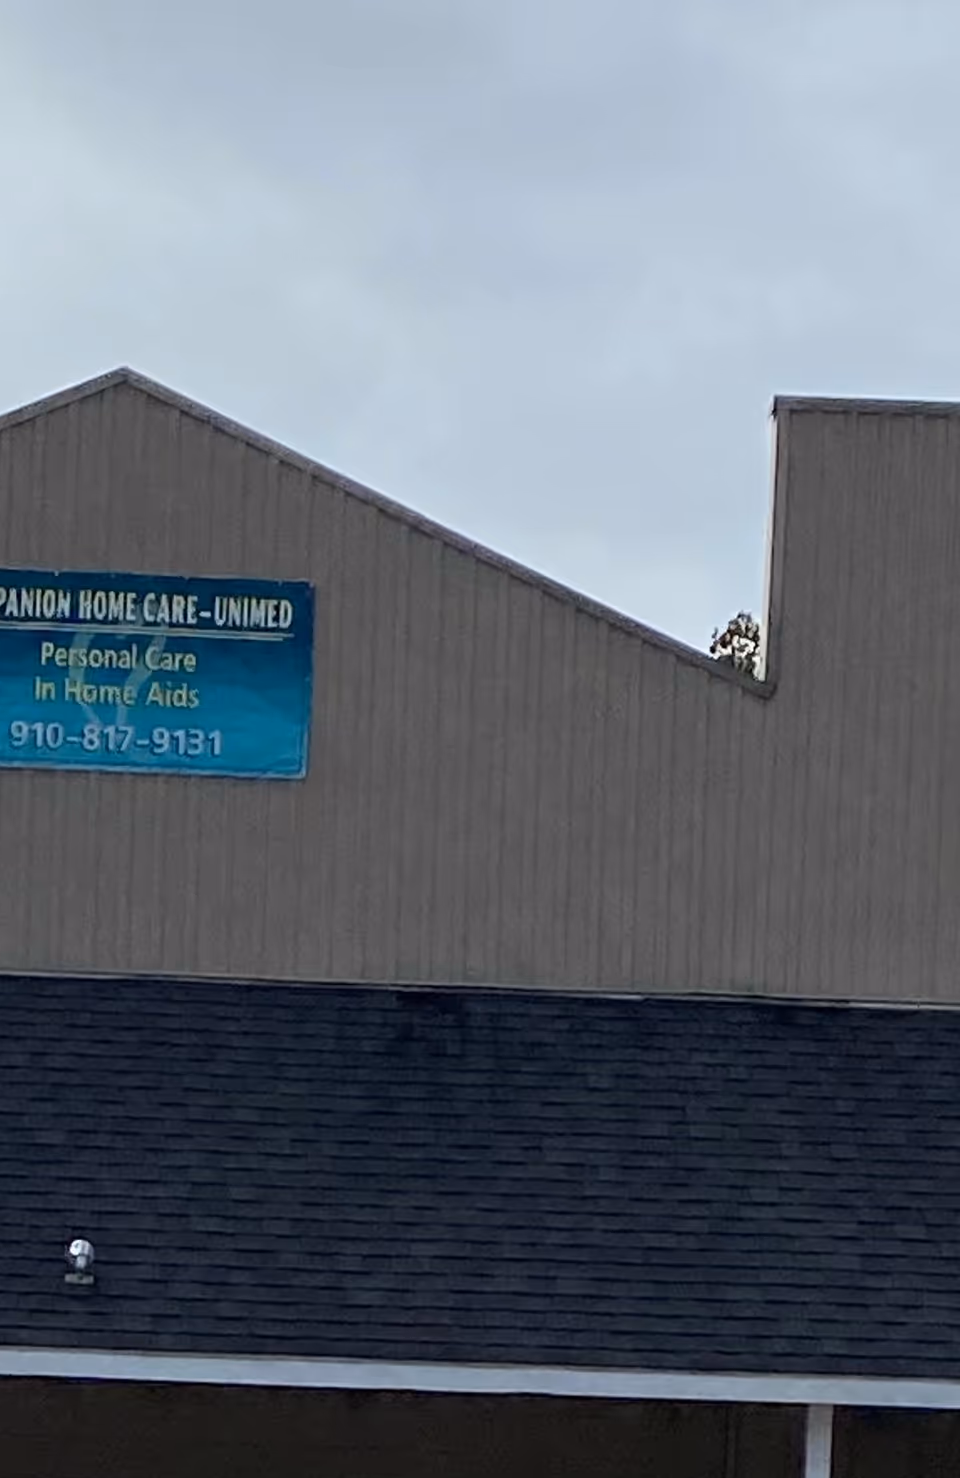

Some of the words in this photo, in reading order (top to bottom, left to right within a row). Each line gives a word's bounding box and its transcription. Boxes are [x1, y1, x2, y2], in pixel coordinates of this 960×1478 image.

[79, 589, 137, 622] HOME
[40, 641, 137, 671] Personal
[144, 647, 197, 673] Care
[64, 680, 136, 707] Home
[145, 682, 200, 709] Aids
[9, 720, 223, 756] 910-817-9131
